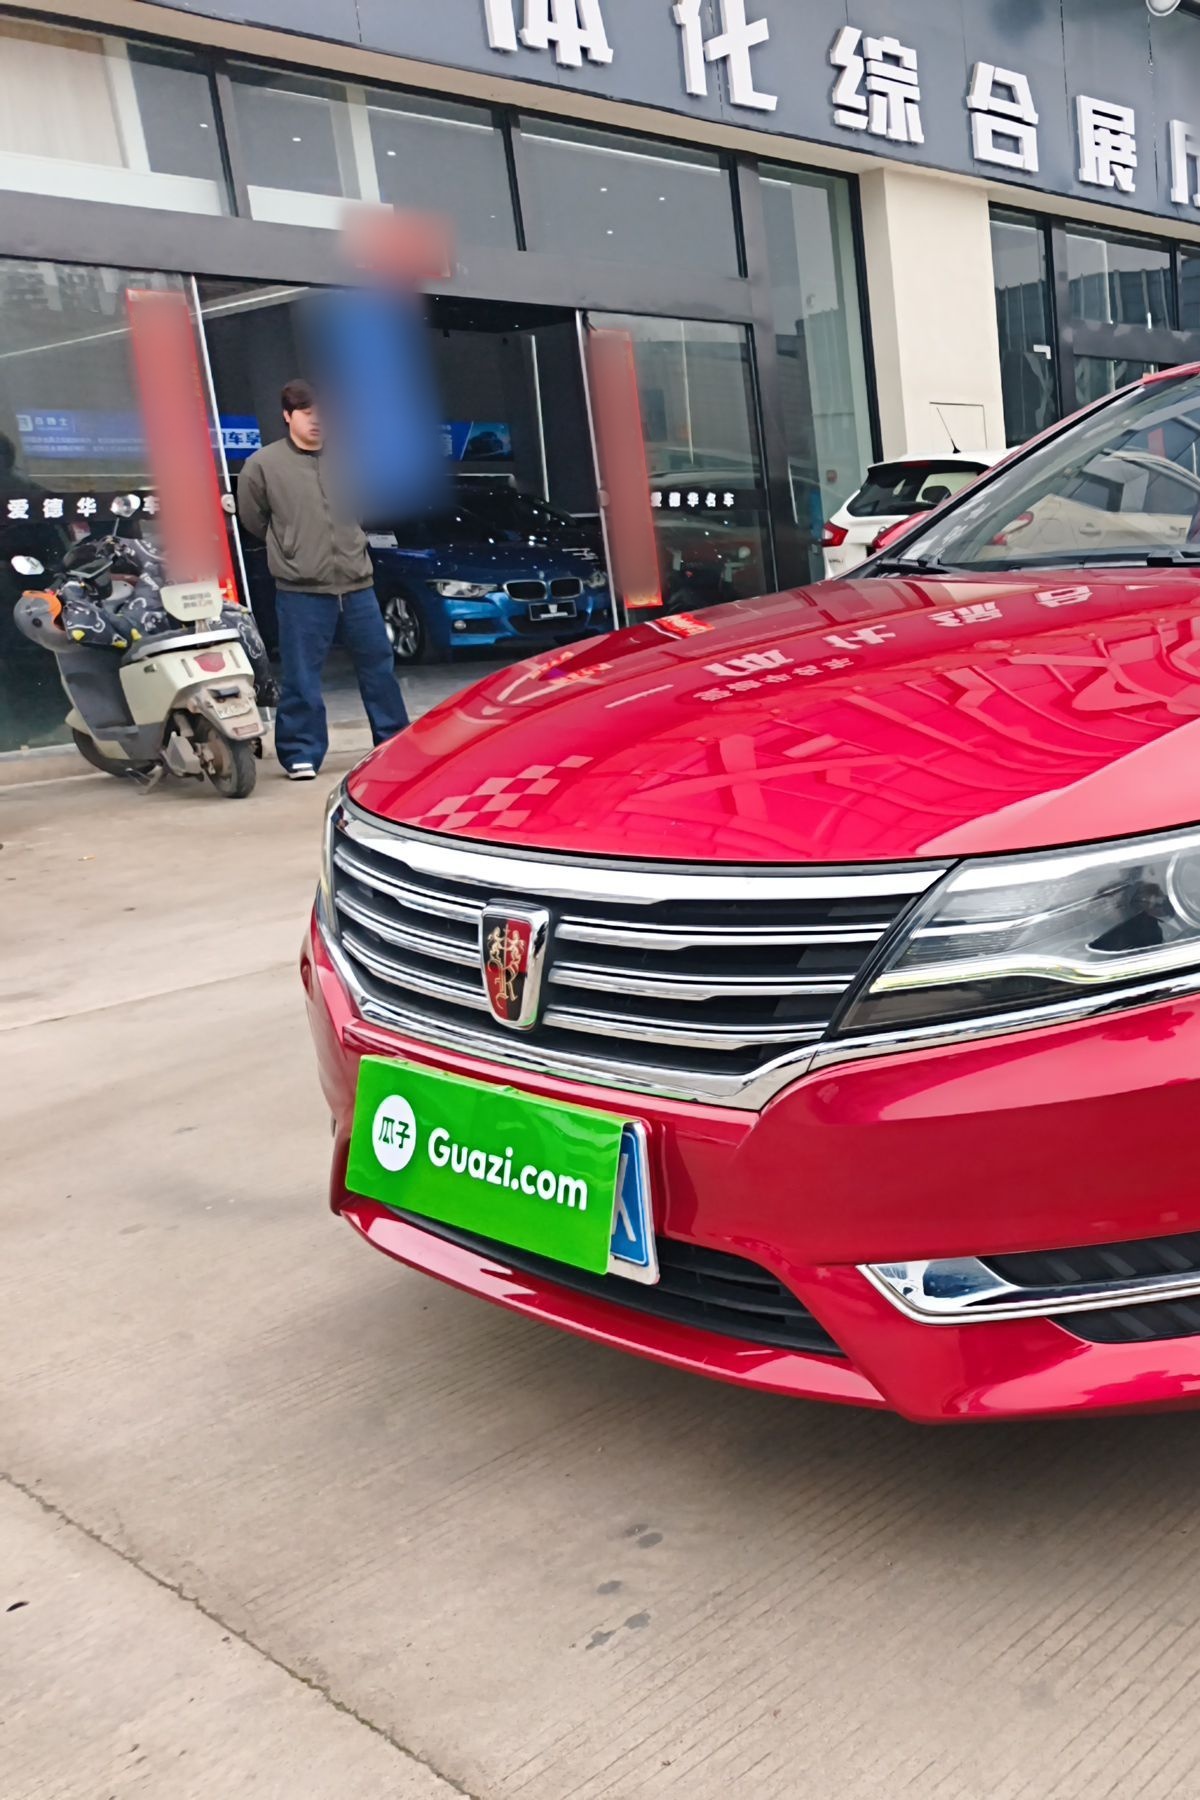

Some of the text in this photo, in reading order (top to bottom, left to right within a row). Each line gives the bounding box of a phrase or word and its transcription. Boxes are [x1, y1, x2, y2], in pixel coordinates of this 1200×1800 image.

[7, 496, 161, 519] 爱德华车
[378, 1116, 588, 1211] 瓜子 Guazi.com
